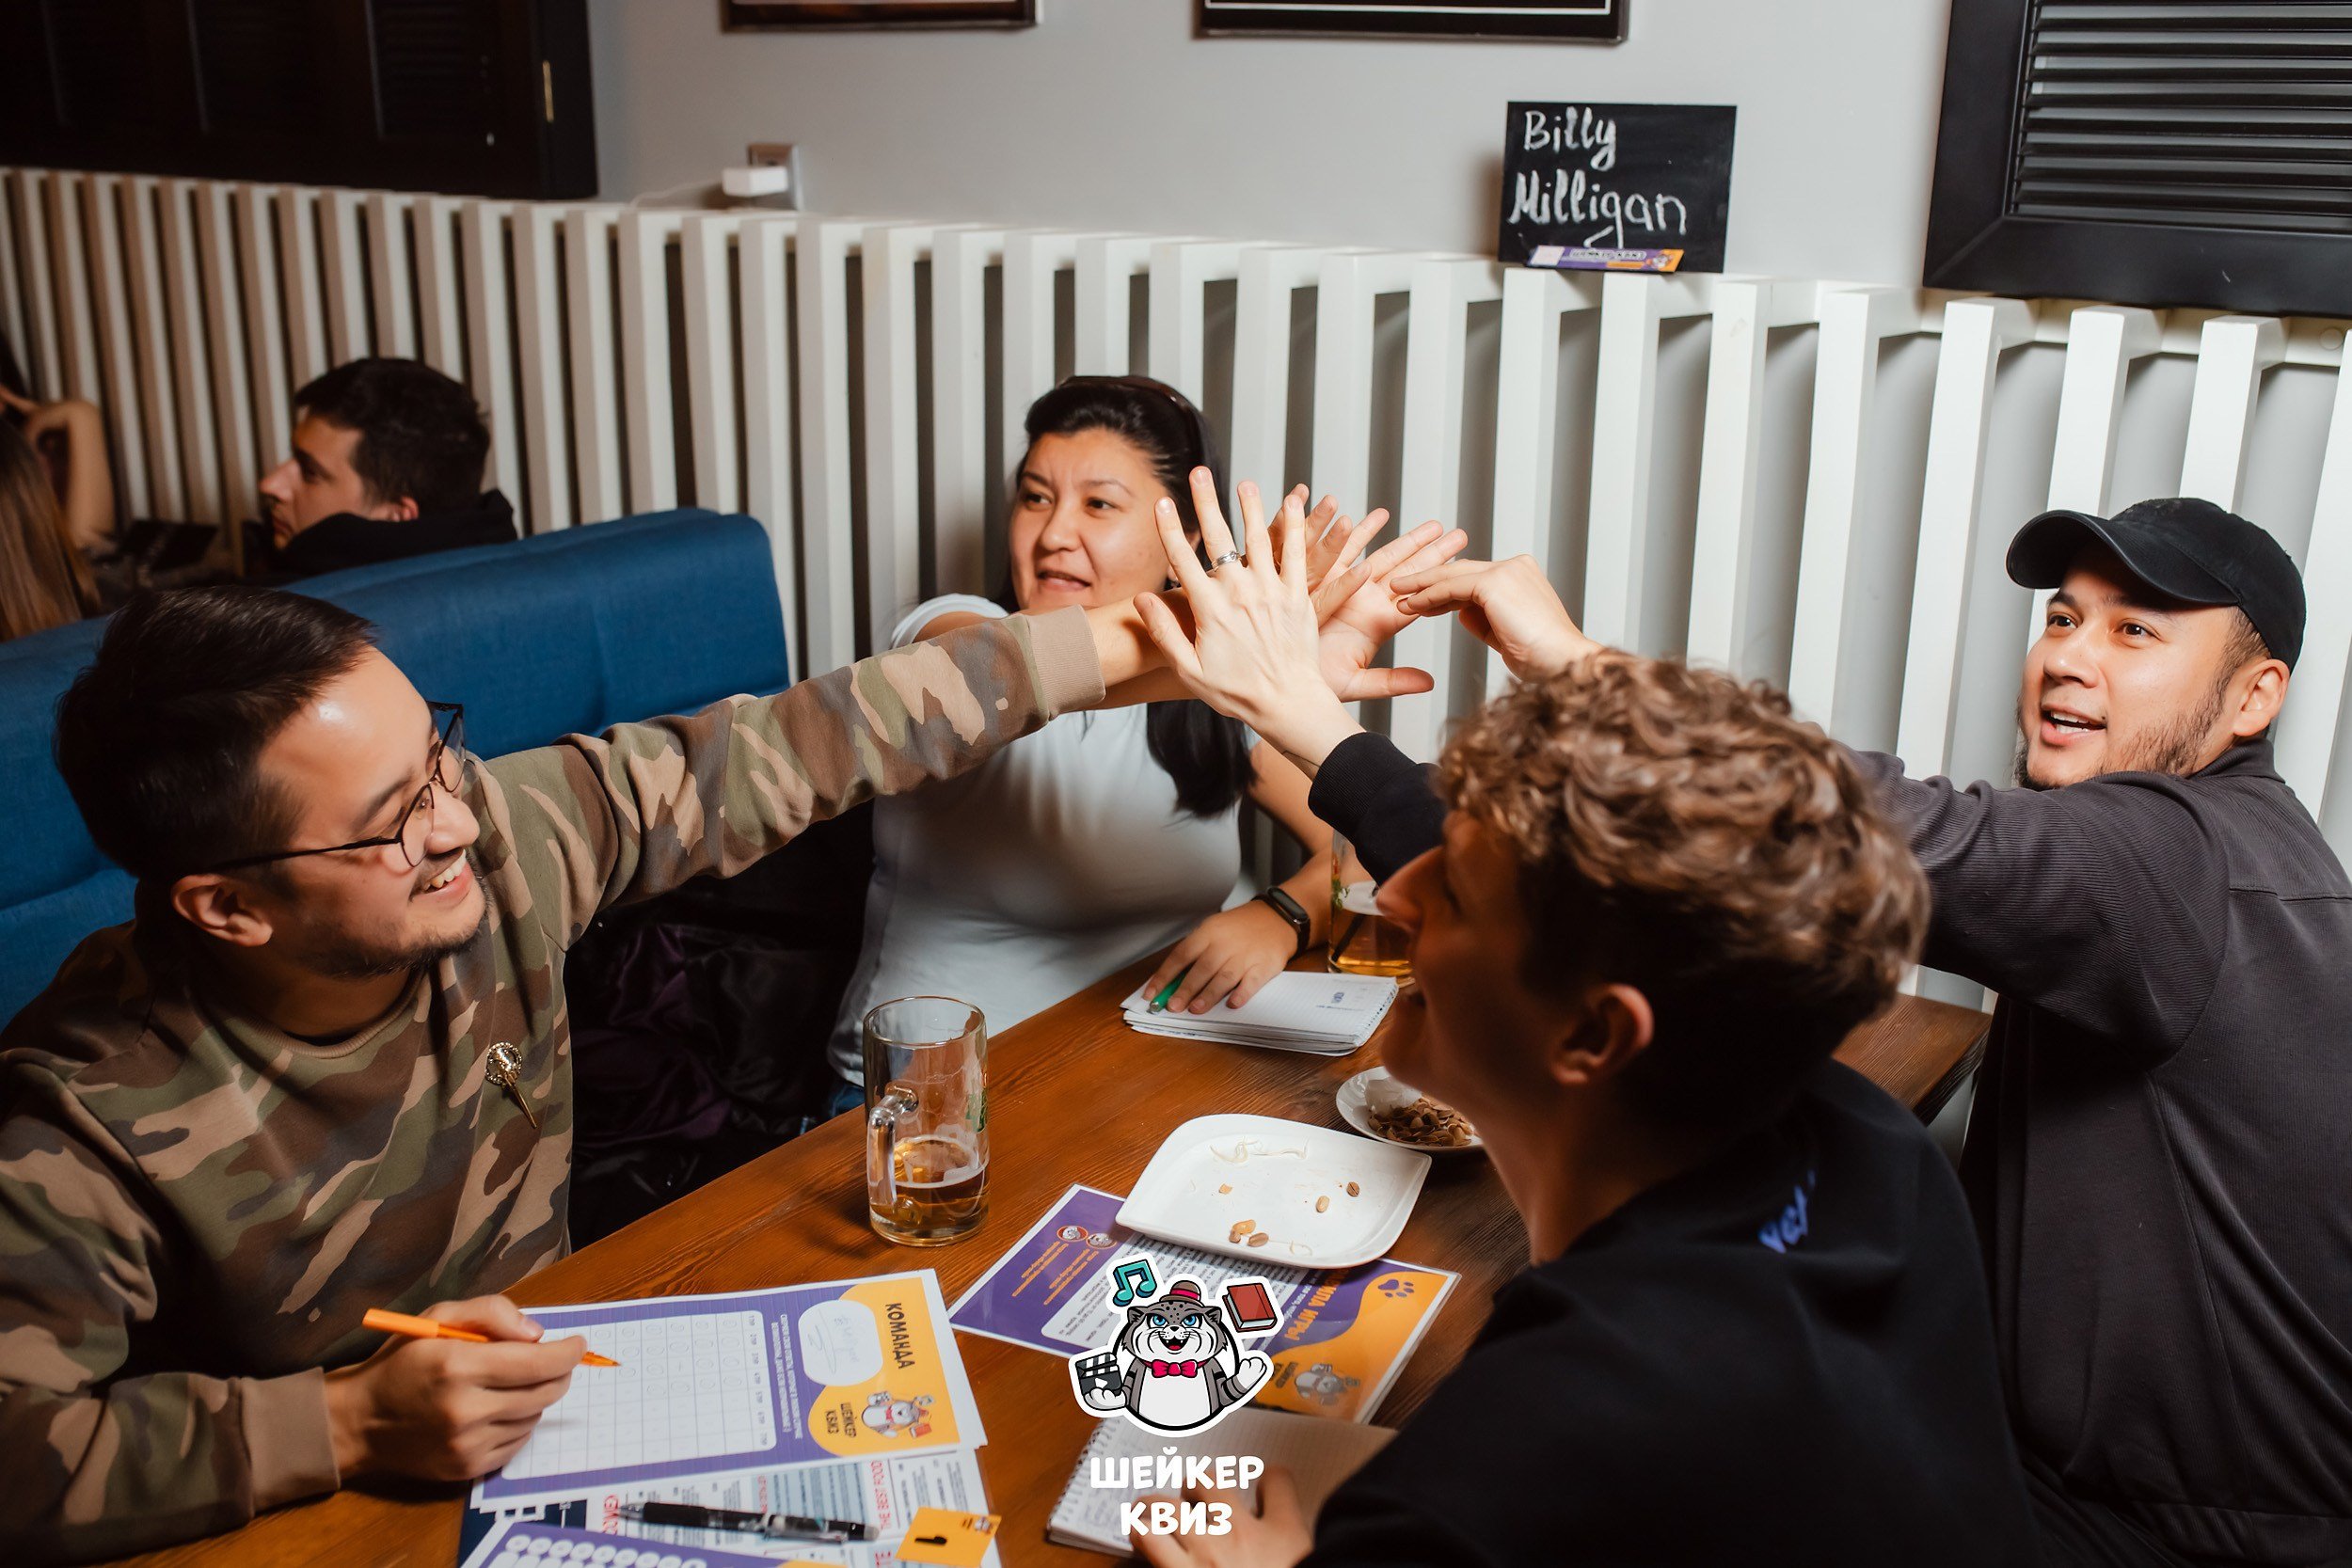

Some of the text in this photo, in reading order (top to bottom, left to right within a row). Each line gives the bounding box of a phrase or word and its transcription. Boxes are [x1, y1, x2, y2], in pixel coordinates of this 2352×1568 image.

[1523, 106, 1616, 171] Billy
[1507, 168, 1687, 249] Milligan
[884, 1303, 915, 1370] КОМАНДА
[1284, 1308, 1319, 1341] ИГРЫ
[875, 1487, 889, 1510] BEST
